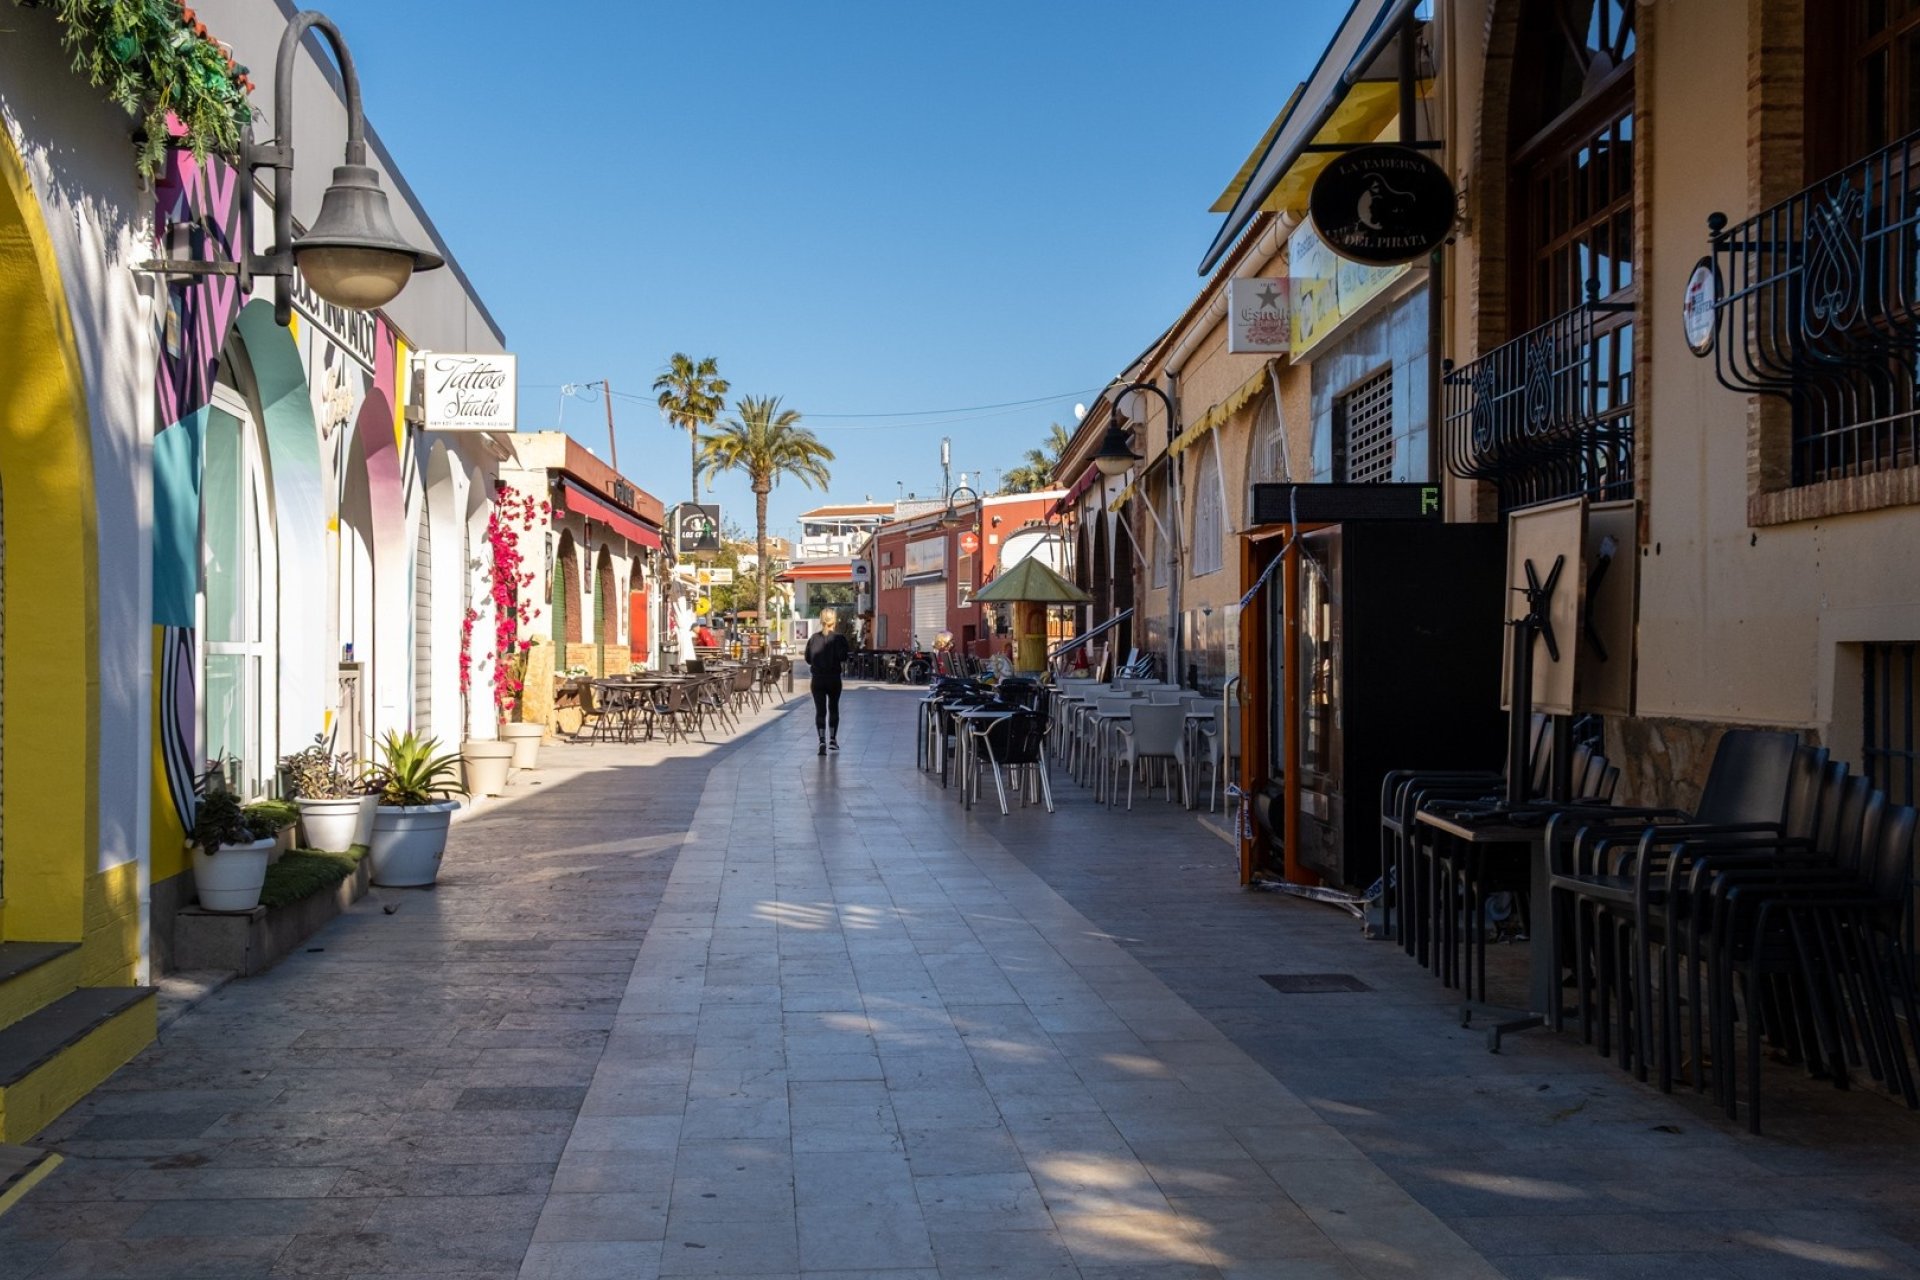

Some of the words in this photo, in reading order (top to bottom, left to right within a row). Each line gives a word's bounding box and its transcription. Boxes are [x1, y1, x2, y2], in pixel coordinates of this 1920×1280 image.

[1338, 162, 1358, 176] LA
[1361, 157, 1426, 175] TABERNA
[1344, 233, 1374, 248] DEL
[1377, 232, 1428, 249] PIRATA
[434, 357, 506, 394] Tattoo
[443, 388, 500, 419] Studio
[1420, 487, 1439, 515] R
